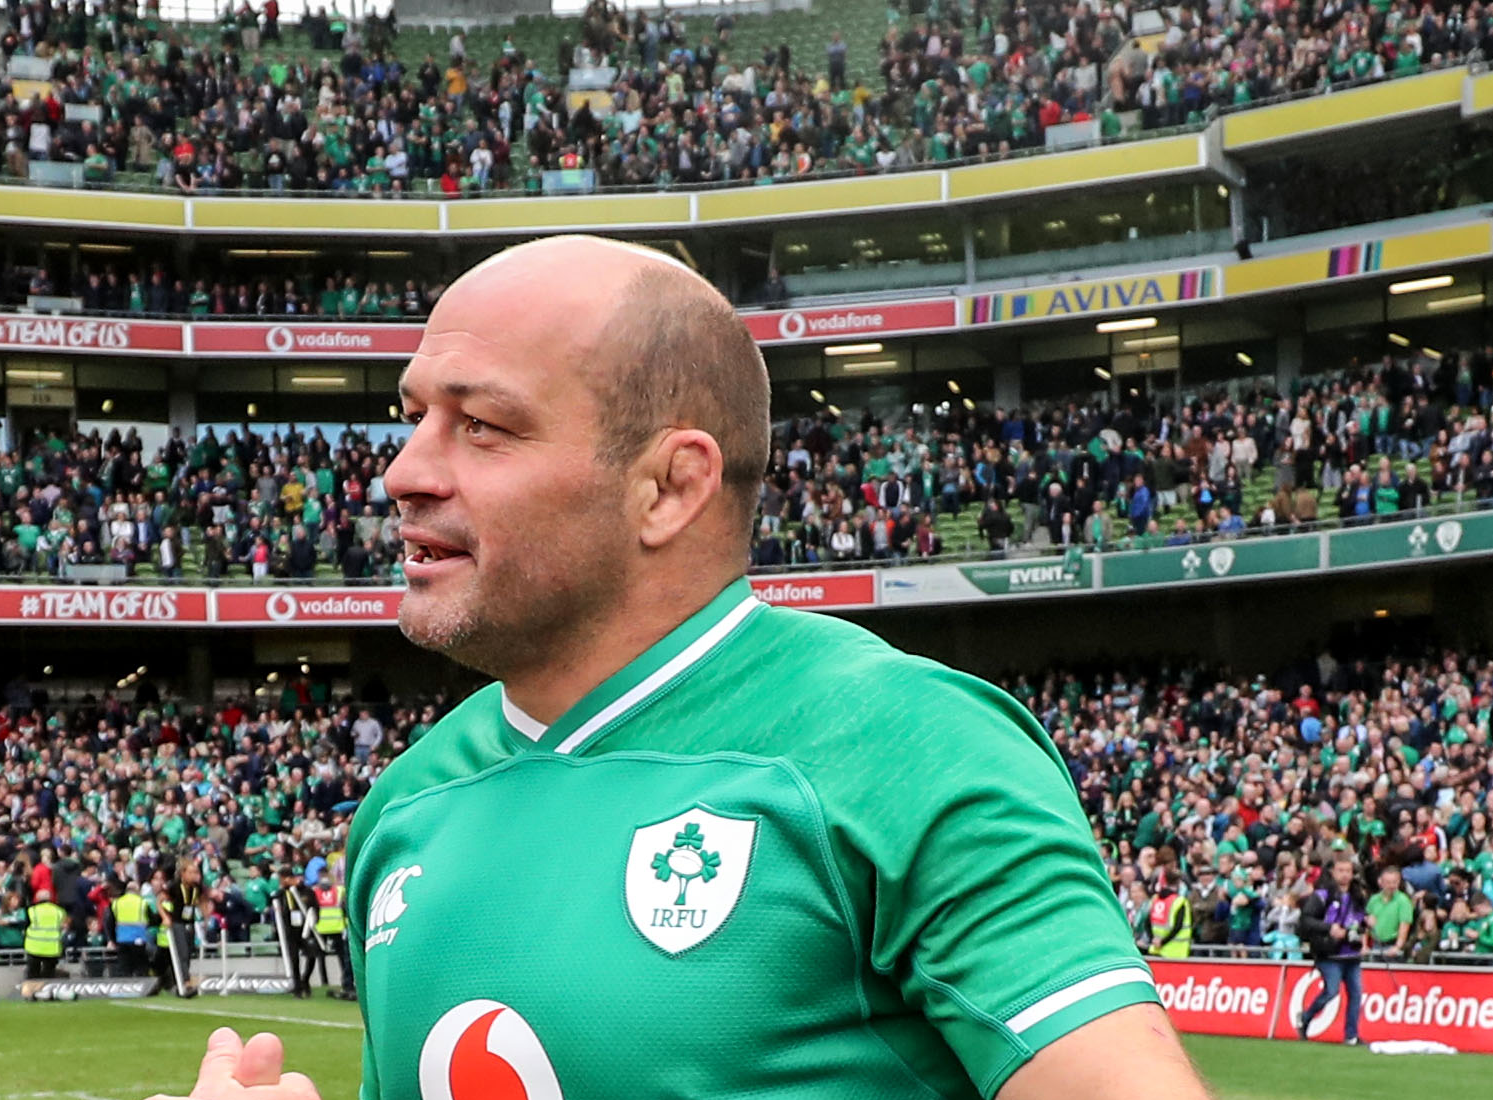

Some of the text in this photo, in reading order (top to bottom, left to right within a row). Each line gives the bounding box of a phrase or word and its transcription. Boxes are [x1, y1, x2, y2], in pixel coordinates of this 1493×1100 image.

[1047, 279, 1165, 315] AVIVA
[808, 311, 884, 331] vodafone
[296, 331, 372, 347] vodafone
[1010, 566, 1075, 584] EVENT
[753, 583, 825, 601] odafone
[300, 597, 384, 615] vodafone
[650, 908, 708, 929] IRFU
[1361, 985, 1493, 1029] odafone
